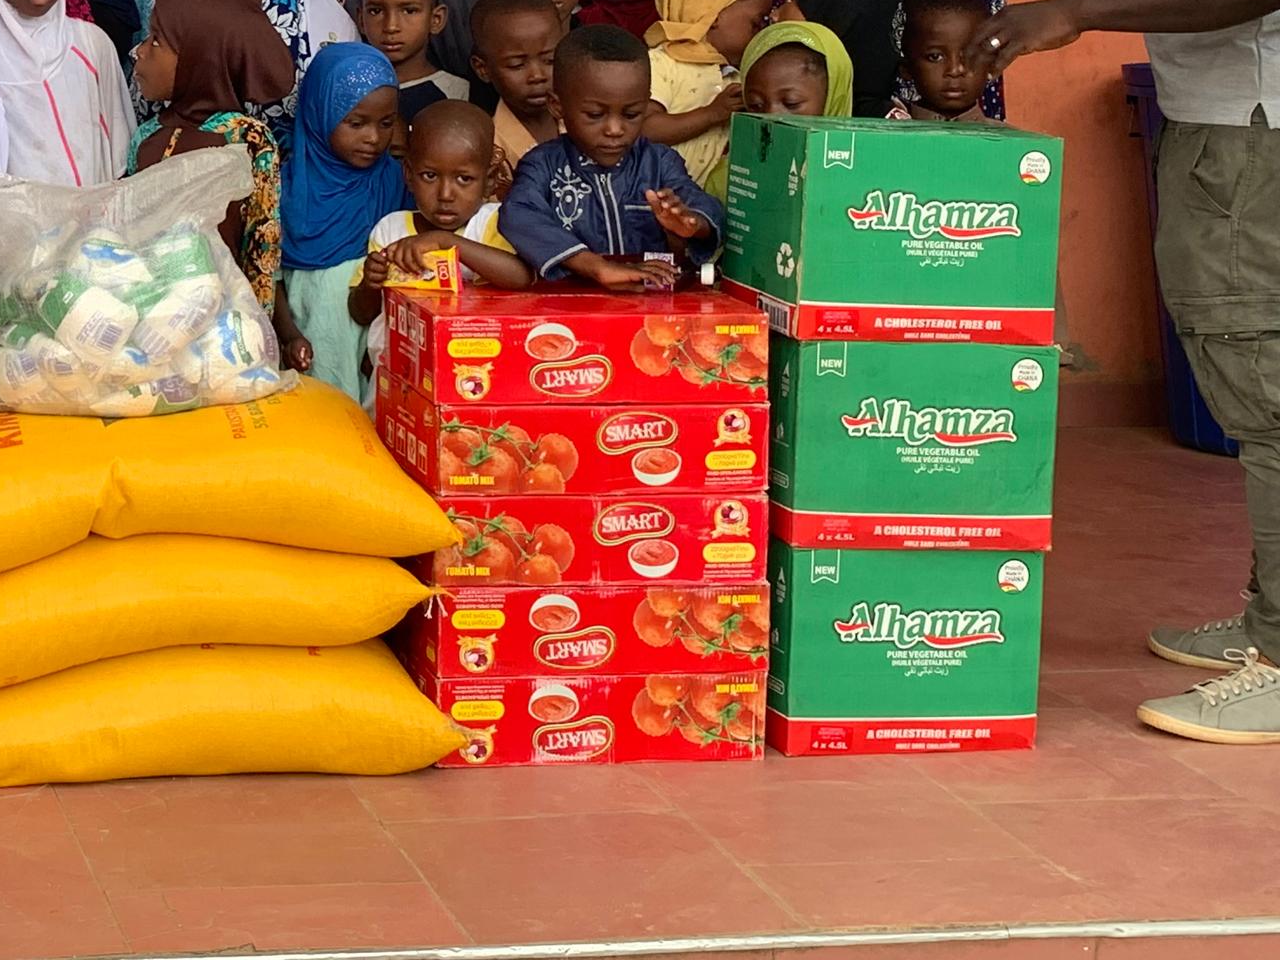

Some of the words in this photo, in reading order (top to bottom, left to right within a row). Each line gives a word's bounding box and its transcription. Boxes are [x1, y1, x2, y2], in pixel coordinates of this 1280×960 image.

[828, 151, 850, 160] NEW
[848, 190, 1021, 240] Alhamza
[901, 240, 924, 249] PURE
[924, 240, 969, 250] VEGETABLE
[970, 241, 984, 250] OIL
[874, 317, 883, 328] A
[884, 318, 957, 329] CHOLESTEROL
[959, 320, 983, 329] FREE
[985, 320, 1002, 330] OIL
[821, 359, 843, 369] NEW
[542, 367, 605, 388] SMART
[841, 397, 1017, 446] Alhamza
[605, 419, 666, 442] SMART
[896, 447, 918, 455] PURE
[919, 447, 966, 456] VEGETABLE
[966, 448, 980, 456] OIL
[449, 475, 478, 486] TOMATO
[480, 475, 495, 486] MIX
[602, 511, 663, 534] SMART
[874, 526, 882, 535] A
[883, 526, 957, 537] CHOLESTEROL
[958, 527, 983, 537] FREE
[985, 528, 1001, 537] OIL
[446, 565, 475, 577] TOMATO
[476, 565, 491, 576] MIX
[815, 565, 836, 575] NEW
[834, 602, 1005, 649] Alhamza
[546, 639, 607, 661] SMART
[886, 650, 907, 658] PURE
[908, 650, 953, 658] VEGETABLE
[954, 650, 968, 658] OIL
[544, 729, 607, 750] SMART
[866, 729, 875, 739] A
[876, 729, 947, 739] CHOLESTEROL
[949, 729, 973, 738] FREE
[974, 729, 991, 738] OIL
